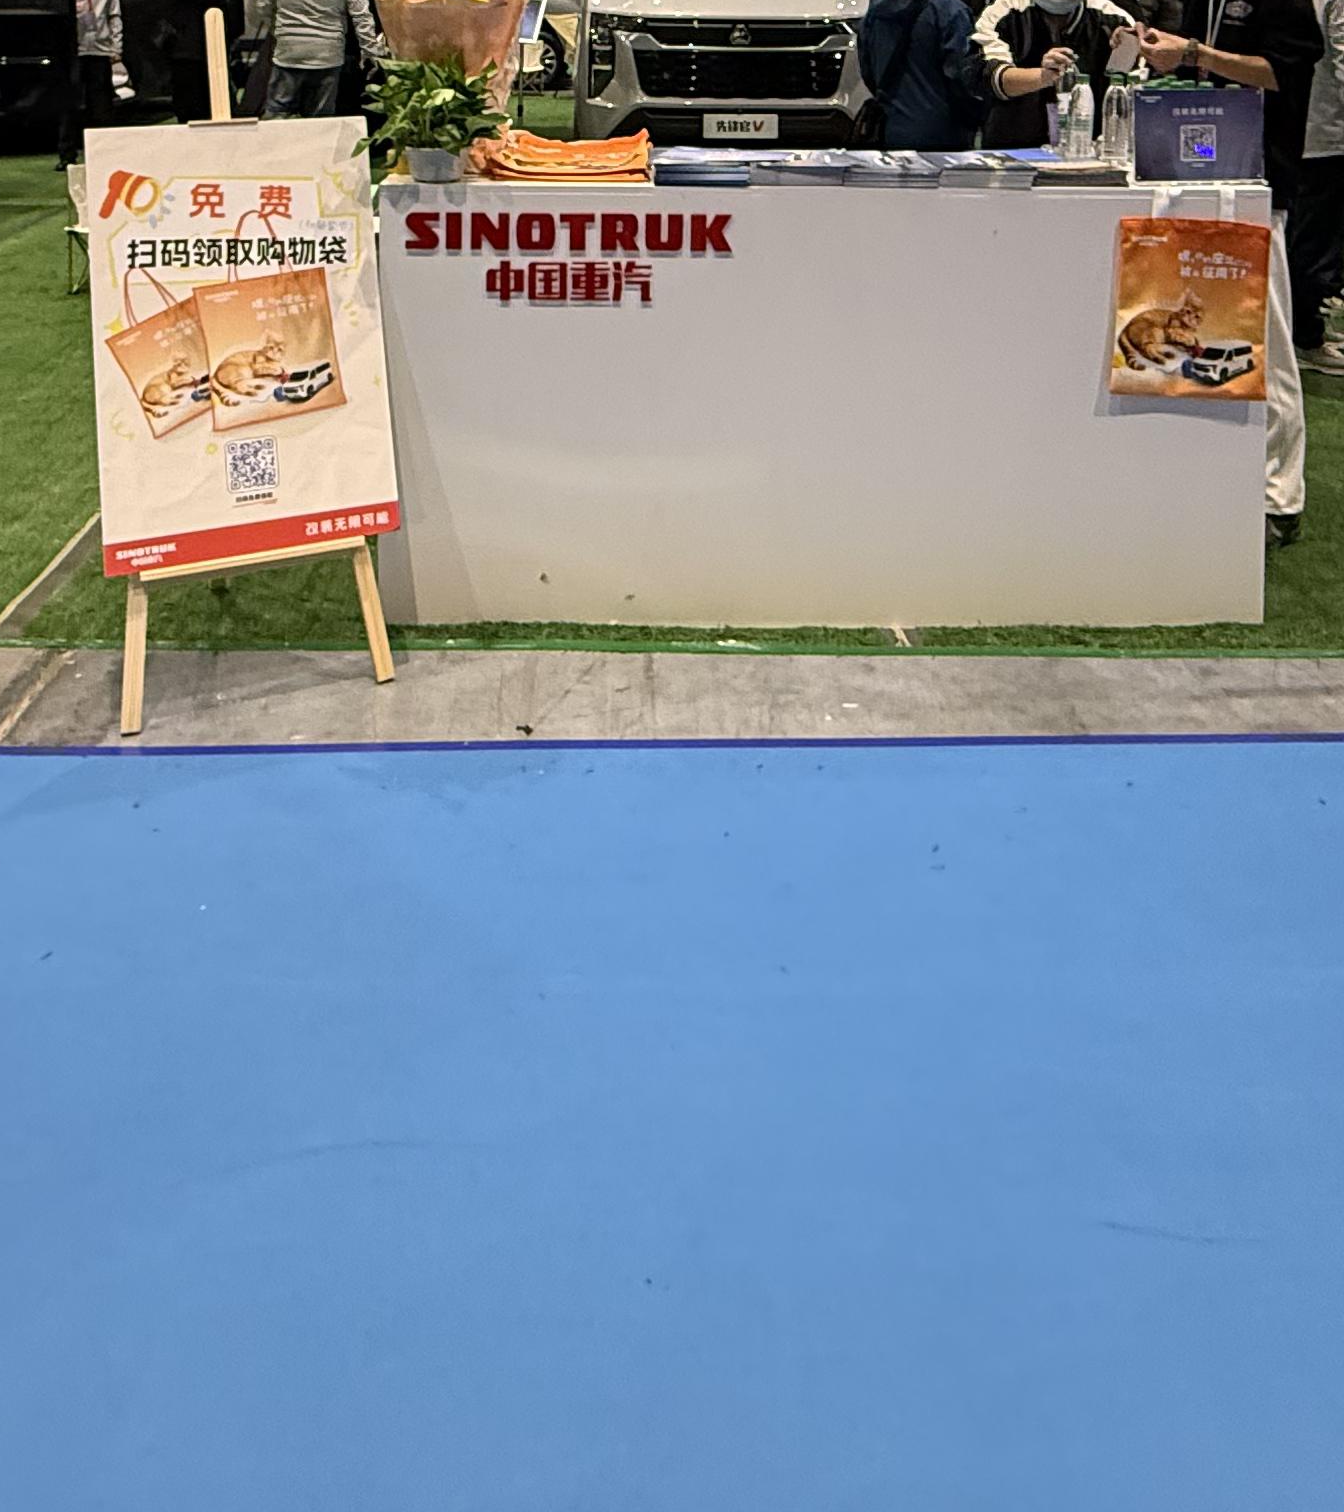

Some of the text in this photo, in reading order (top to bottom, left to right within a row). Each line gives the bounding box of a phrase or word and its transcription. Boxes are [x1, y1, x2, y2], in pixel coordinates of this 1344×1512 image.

[404, 212, 734, 253] SINOTRUK
[126, 236, 348, 270] 扫码领取购物袋
[485, 260, 653, 302] 中国重汽
[114, 542, 178, 561] SINOTRUK
